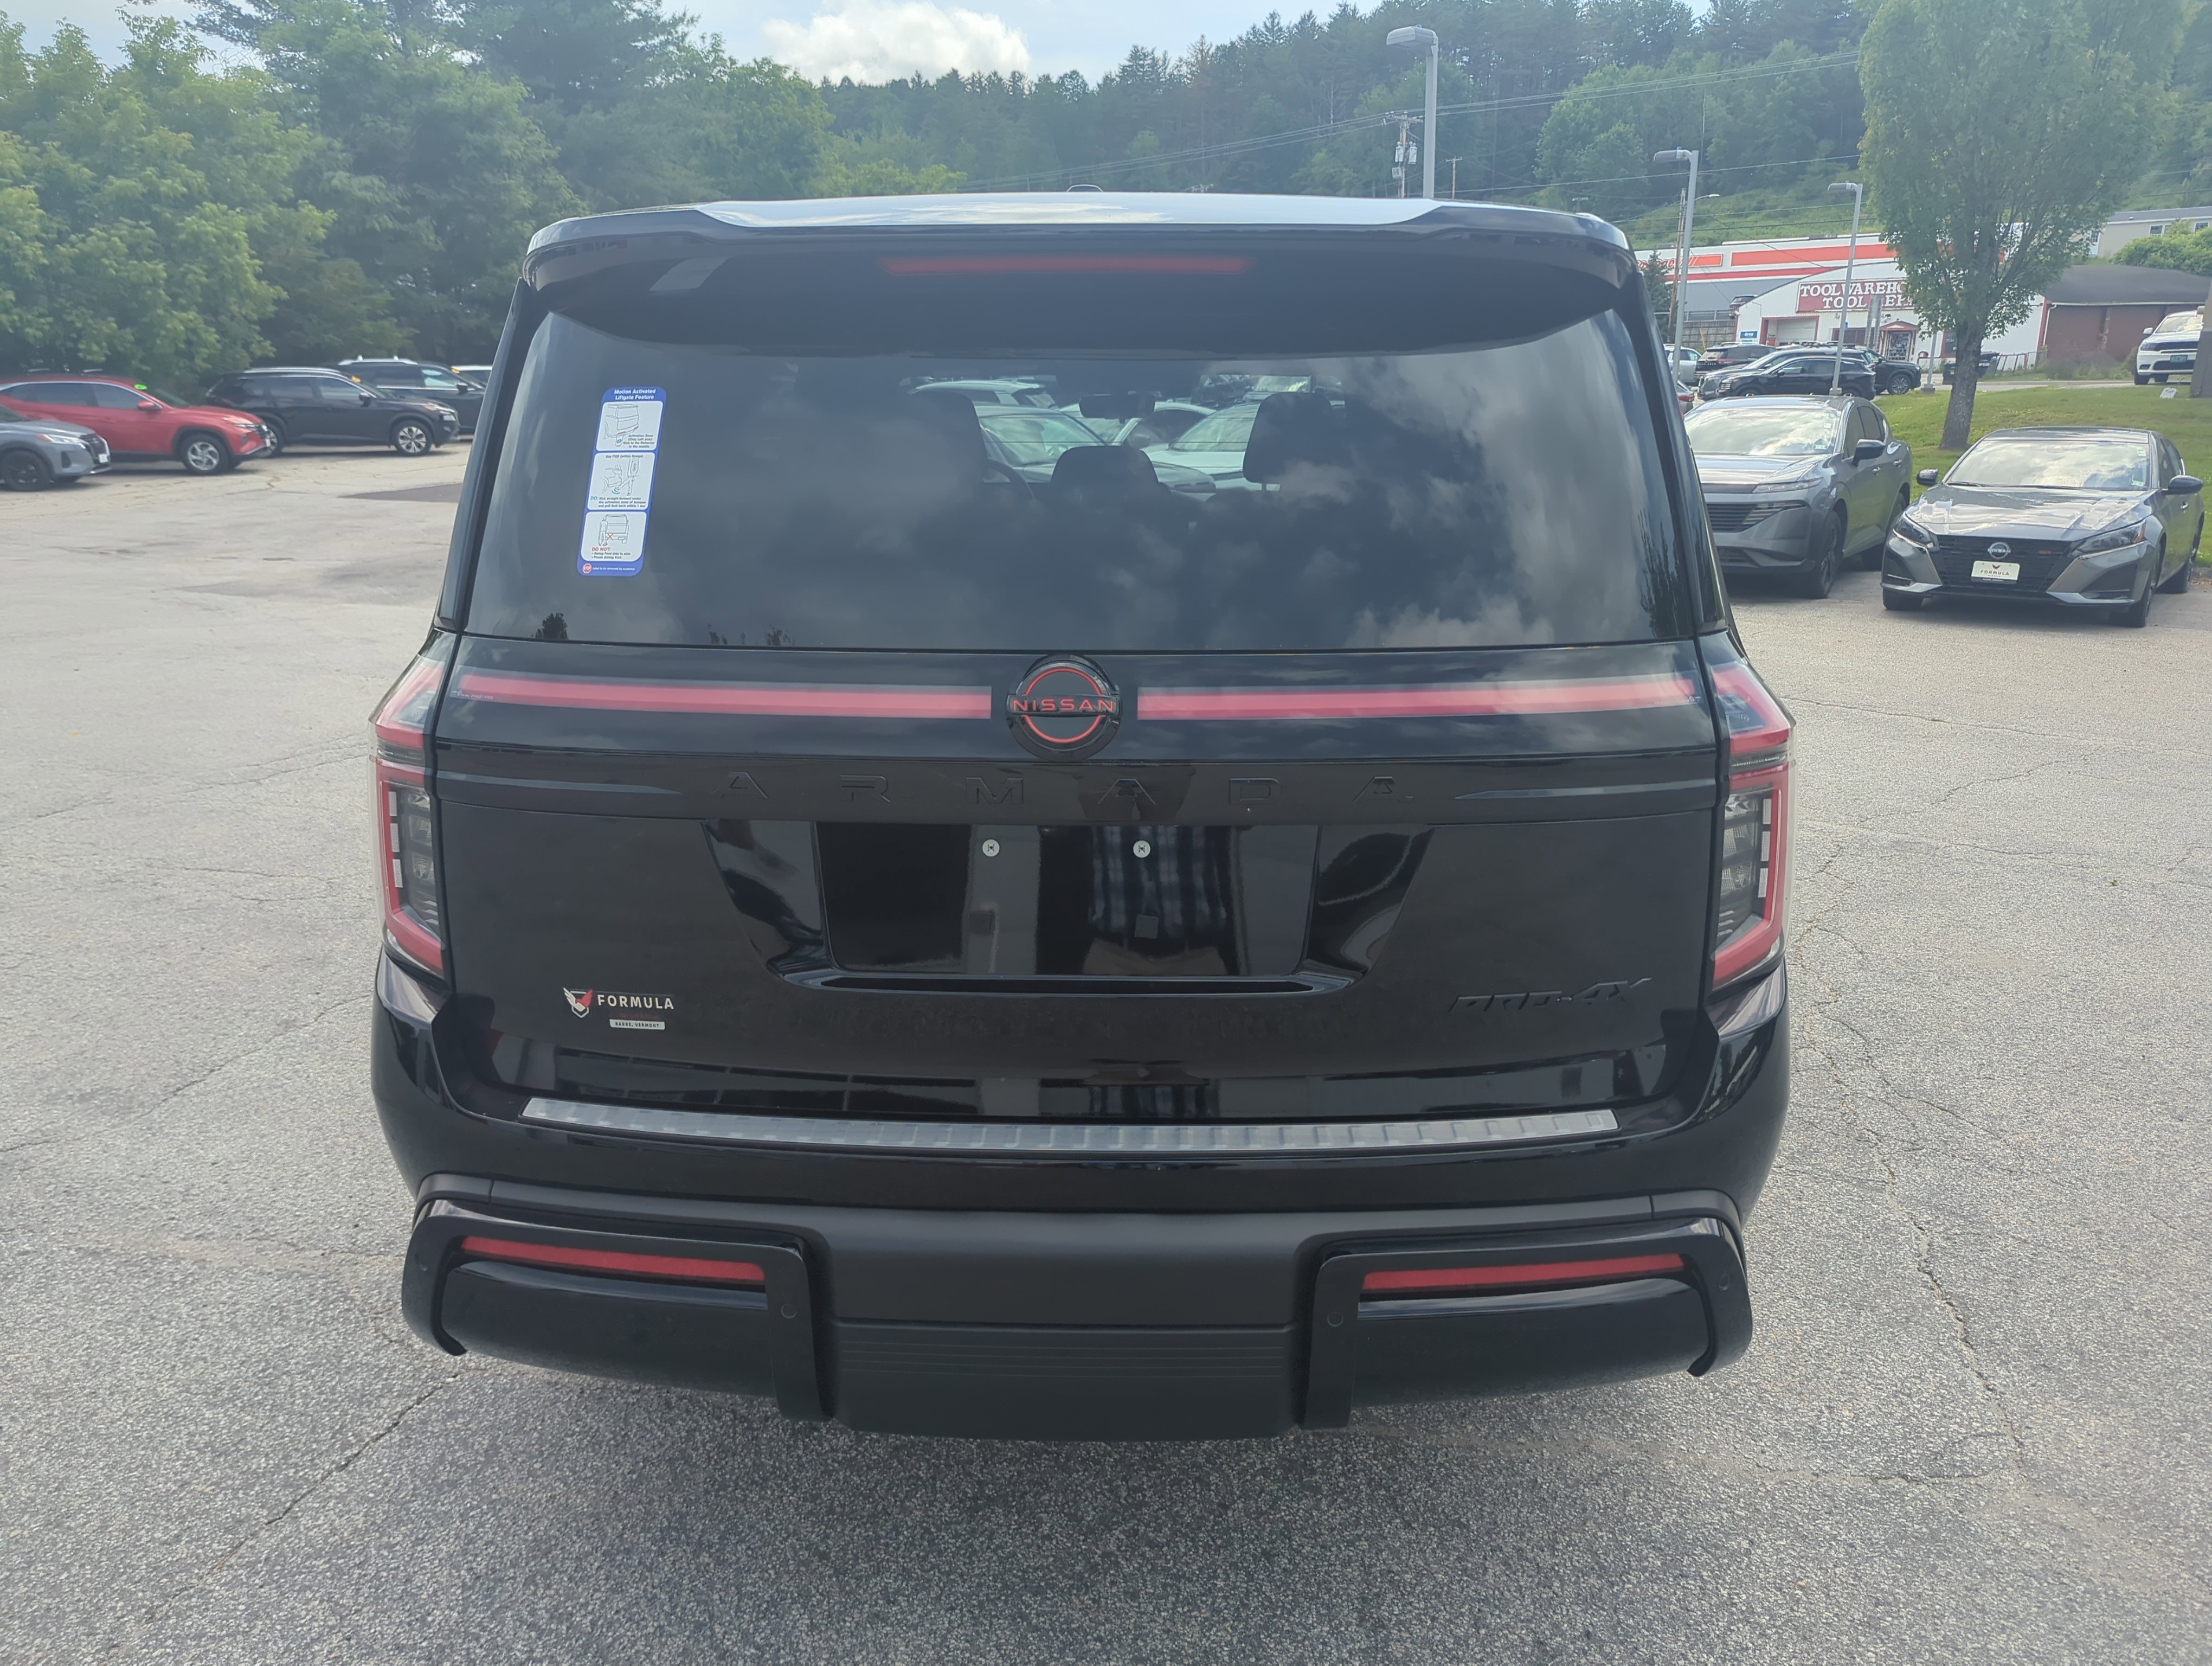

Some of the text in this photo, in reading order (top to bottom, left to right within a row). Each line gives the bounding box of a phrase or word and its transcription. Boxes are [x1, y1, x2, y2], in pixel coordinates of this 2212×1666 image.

[1823, 296, 1868, 309] TOOL
[1012, 697, 1115, 712] NISSAN
[710, 771, 1414, 804] ARMADA
[597, 994, 674, 1009] FORMULA
